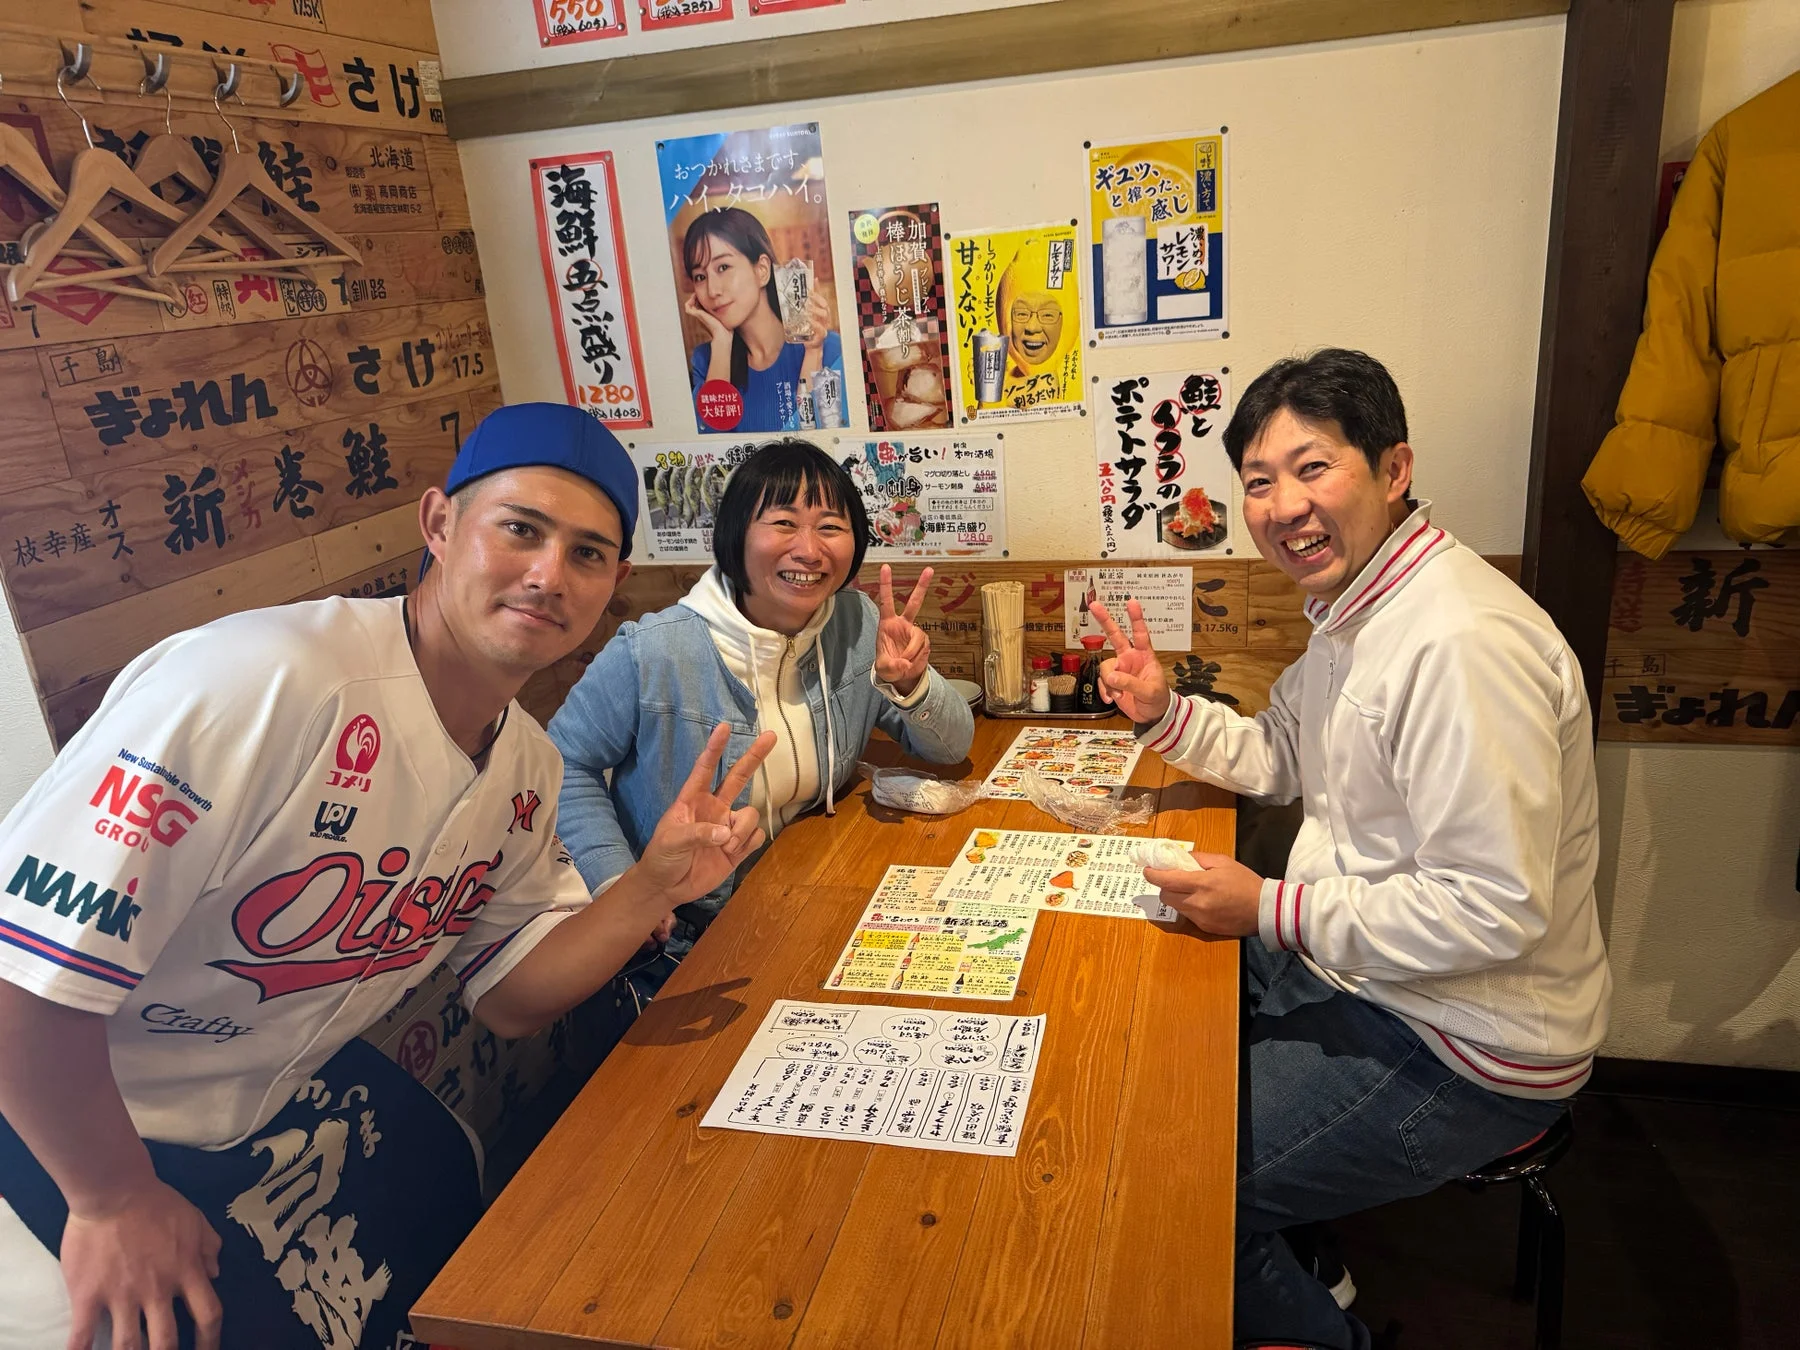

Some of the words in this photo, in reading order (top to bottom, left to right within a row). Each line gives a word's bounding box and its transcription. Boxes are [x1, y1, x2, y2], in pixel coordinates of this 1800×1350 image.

[342, 56, 420, 119] さけ
[370, 146, 415, 171] 北海道
[674, 149, 808, 181] おつかれさまです、
[669, 176, 823, 213] ハイ、タコハイ。
[1151, 194, 1189, 222] 感じ
[908, 220, 927, 264] 加賀
[1160, 243, 1176, 276] サワー
[1175, 230, 1190, 272] レモン
[1190, 226, 1204, 266] 濃いめの
[350, 278, 387, 301] 釧路
[546, 163, 621, 384] 海鮮五点盛り
[886, 221, 913, 359] 棒ほうじ茶割り
[920, 267, 931, 313] プレミアム
[983, 238, 996, 327] しっかりレモンで
[955, 240, 979, 348] 甘くない!
[60, 348, 123, 383] 千島
[347, 338, 436, 394] さけ
[452, 353, 484, 379] 17.5
[1004, 373, 1054, 398] ソーダで
[83, 372, 279, 445] ぎょれん
[579, 384, 634, 404] 1280
[1014, 386, 1060, 409] 割るだけ!
[1179, 374, 1221, 438] 鮭と
[954, 448, 994, 460] 本町酒場
[1111, 377, 1157, 530] ポテトサラダ
[924, 470, 970, 478] マグロ切り落とし
[925, 482, 963, 490] サーモン刺身
[14, 522, 97, 568] 枝幸産
[99, 500, 134, 560] オス
[926, 522, 986, 533] 海鮮五点盛り
[1669, 558, 1770, 637] 新
[1025, 622, 1065, 632] 根室市西
[1205, 623, 1238, 634] 17.5Kg
[118, 748, 138, 763] New
[138, 756, 180, 786] Sustainable
[179, 782, 213, 812] Growth
[326, 770, 371, 792] コメリ
[89, 764, 199, 848] NSG
[141, 1003, 254, 1043] Crafty
